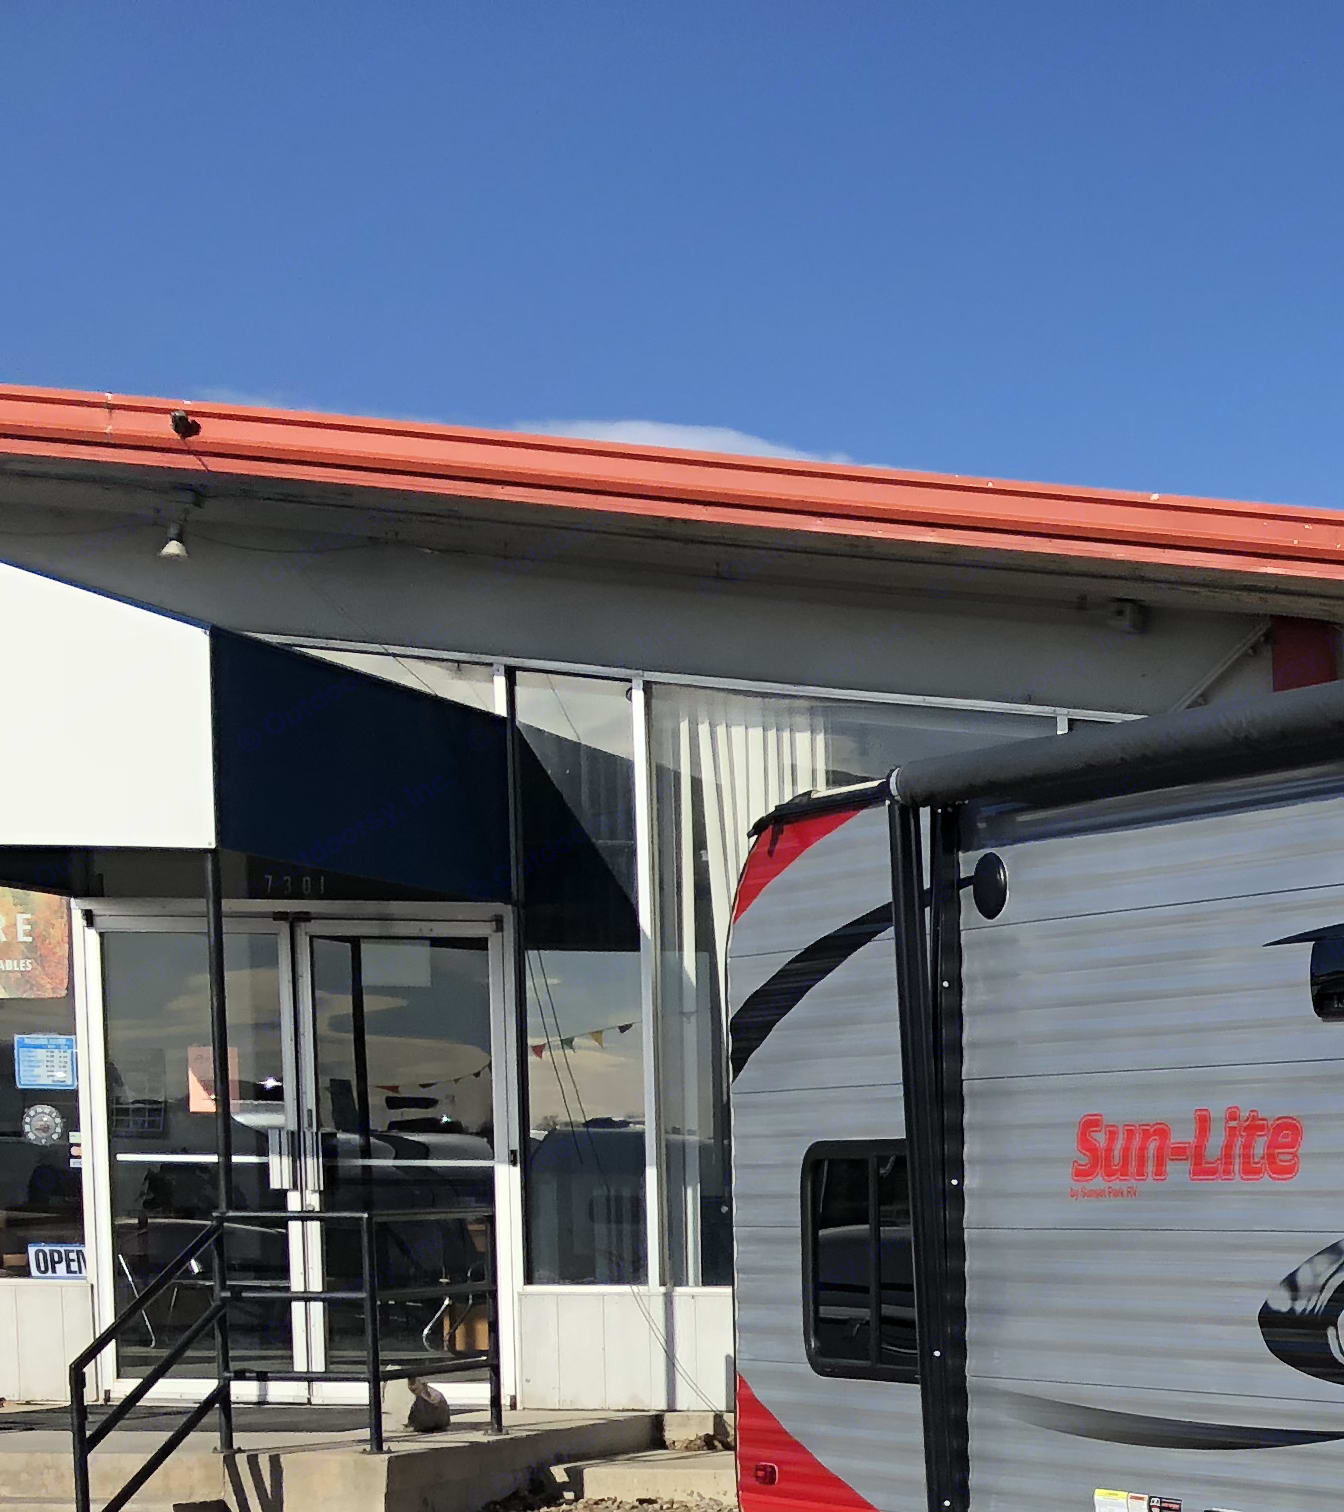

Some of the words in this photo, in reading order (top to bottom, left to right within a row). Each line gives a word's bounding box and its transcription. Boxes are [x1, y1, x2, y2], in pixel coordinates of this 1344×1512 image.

[264, 873, 326, 896] 7301
[1073, 1107, 1303, 1181] Sun-Lite
[34, 1248, 87, 1275] OPEN
